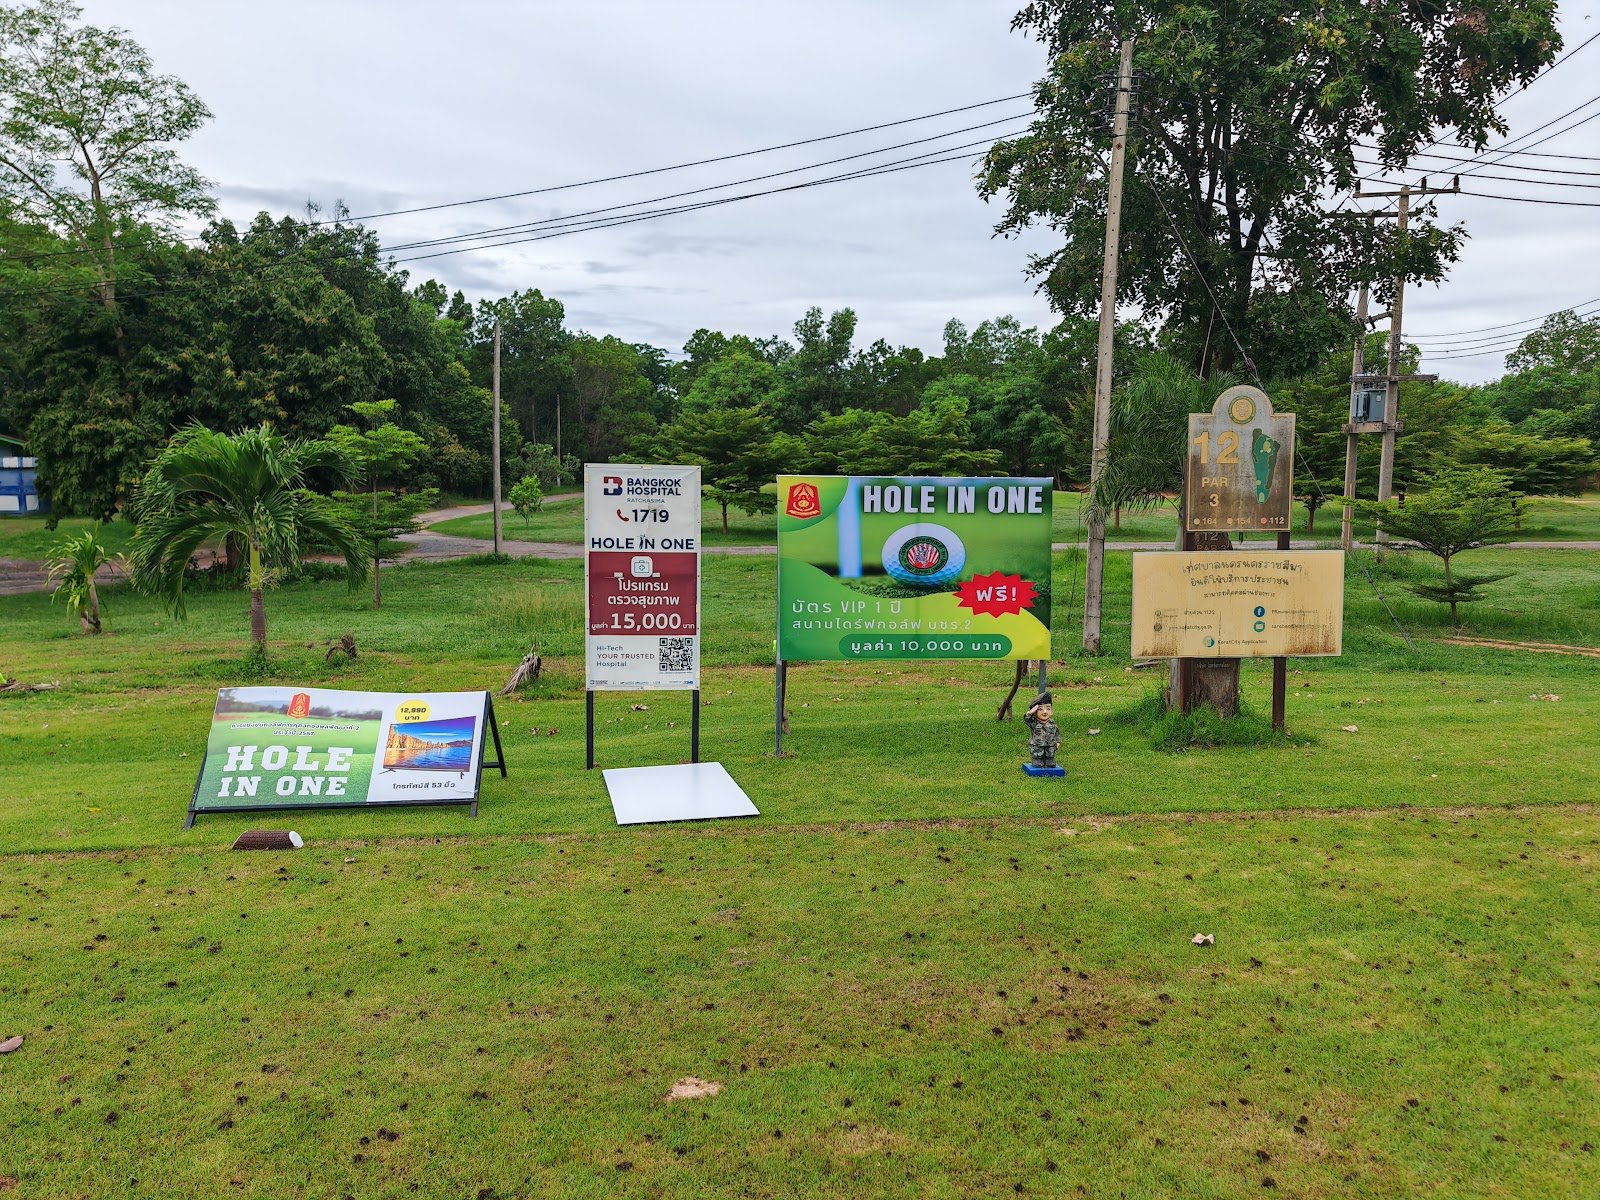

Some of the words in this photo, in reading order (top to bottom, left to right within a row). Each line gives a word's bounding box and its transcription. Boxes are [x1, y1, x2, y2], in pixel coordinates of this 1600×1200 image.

[1194, 431, 1239, 464] 12
[627, 478, 682, 487] BANGKOK
[1201, 477, 1228, 488] PAR
[627, 487, 682, 496] HOSPITAL
[863, 485, 935, 513] HOLE
[947, 485, 975, 513] IN
[987, 486, 1043, 514] ONE
[1209, 493, 1219, 507] 3
[631, 509, 670, 523] 1719
[1202, 517, 1217, 525] 164
[591, 537, 635, 549] HOLE
[660, 538, 695, 549] ONE
[617, 577, 669, 591] โปรแกรม
[976, 585, 1017, 602] ฟรี!
[607, 595, 680, 608] ตรวจสุขภาพ
[792, 599, 832, 613] บัตร
[841, 600, 865, 614] VIP
[875, 600, 881, 614] 1
[890, 599, 901, 613] ปี
[610, 613, 682, 631] 15,000
[792, 617, 922, 630] สนามไดร์ฟกอล์ฟ
[851, 638, 893, 653] มูลค่า
[900, 640, 964, 653] 10,000
[971, 641, 1002, 651] บาท
[222, 745, 354, 772] HOLE
[217, 776, 262, 797] IN
[275, 776, 349, 797] ONE
[431, 781, 443, 789] 53
